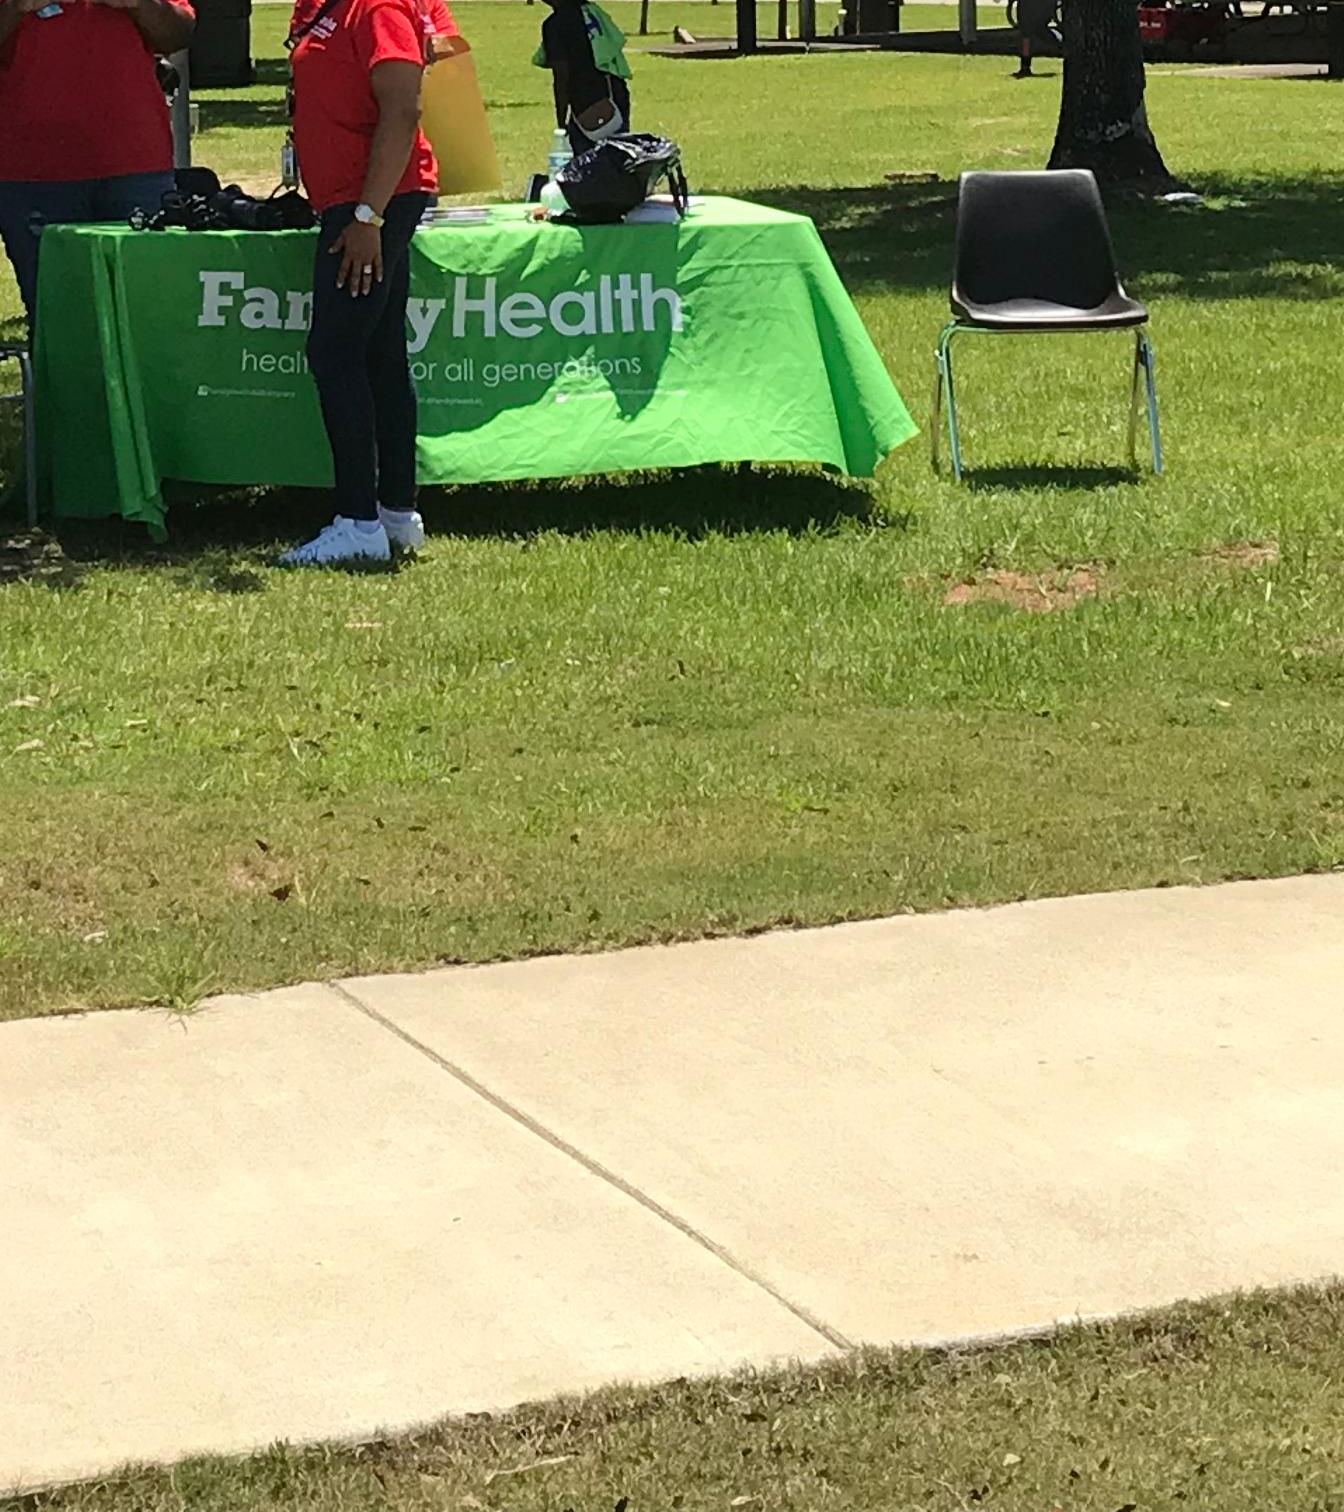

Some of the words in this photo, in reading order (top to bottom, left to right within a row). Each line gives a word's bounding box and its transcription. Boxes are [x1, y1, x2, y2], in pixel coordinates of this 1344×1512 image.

[410, 361, 437, 381] or
[444, 358, 474, 382] all
[482, 356, 642, 387] generations
